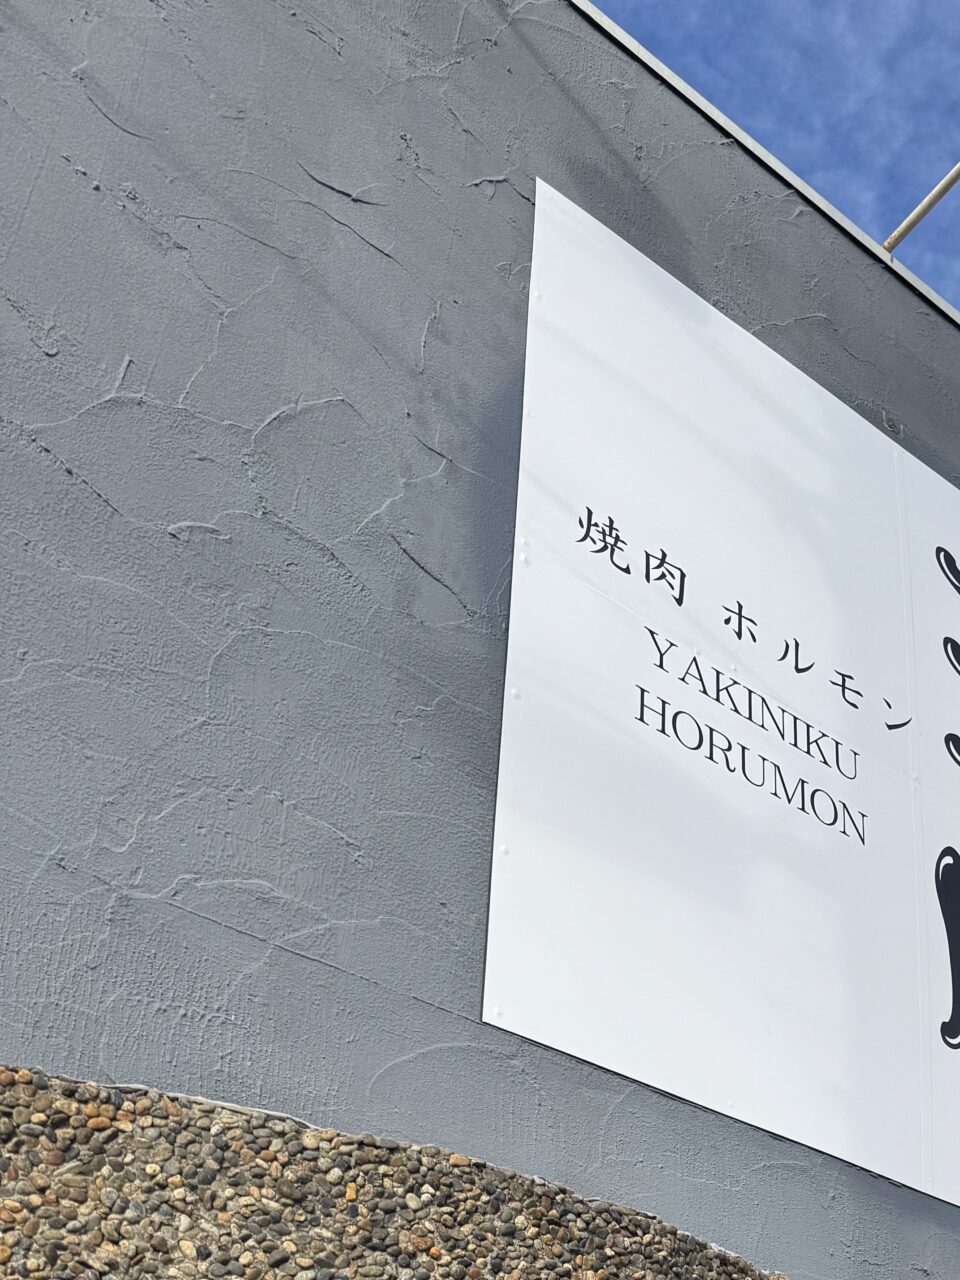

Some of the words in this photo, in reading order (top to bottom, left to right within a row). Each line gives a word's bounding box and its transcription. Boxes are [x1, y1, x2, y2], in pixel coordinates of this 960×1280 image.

[575, 505, 687, 607] 焼肉
[722, 600, 913, 731] ホルモン
[634, 684, 868, 846] HORUMON
[643, 625, 861, 781] YAKINIKU
